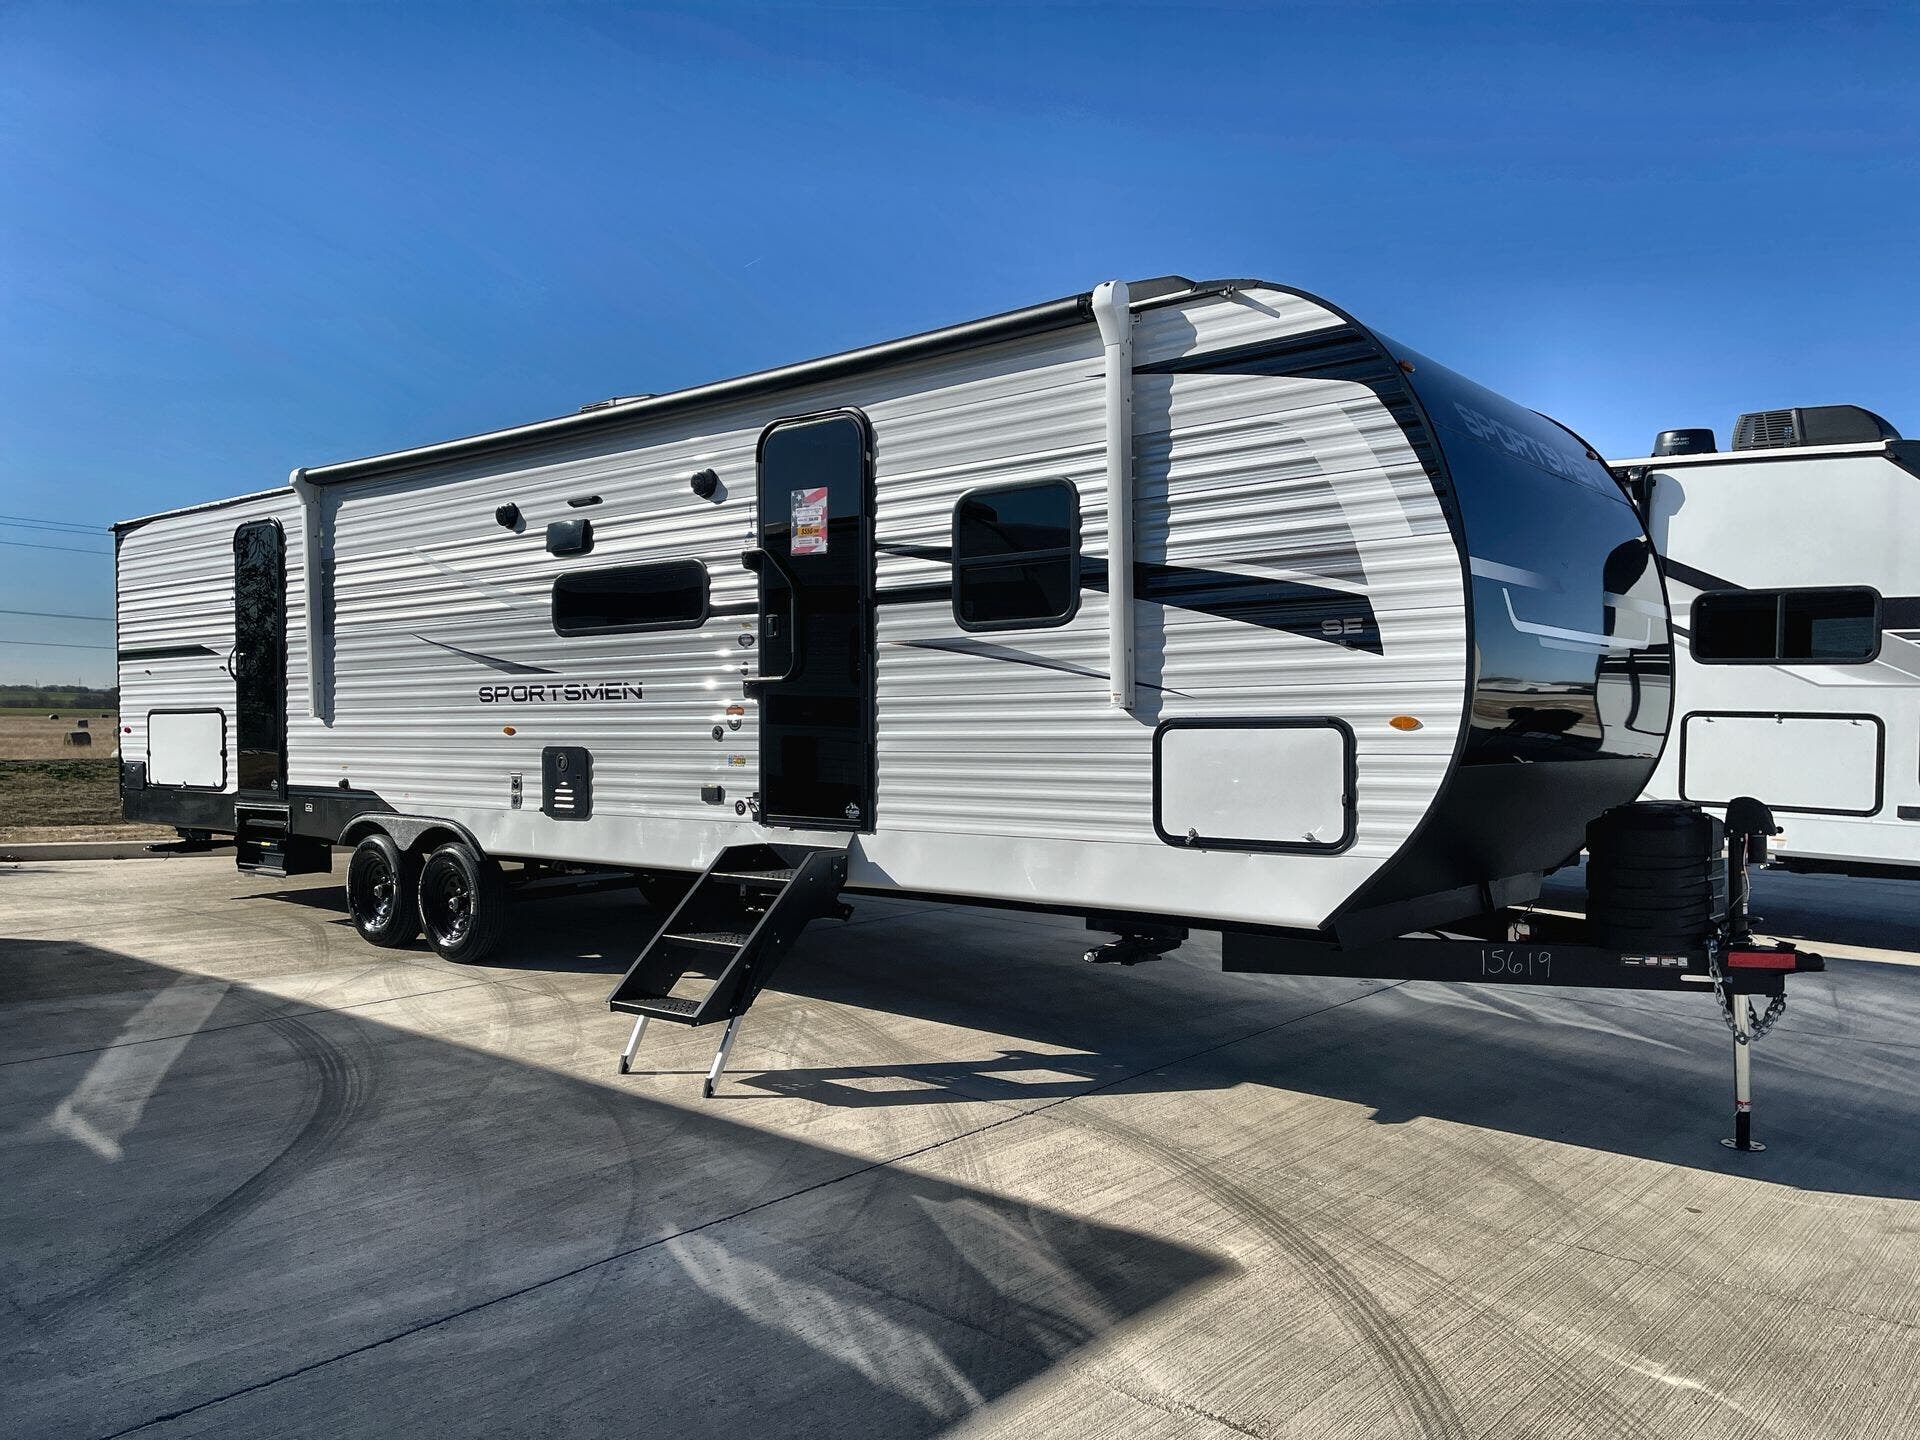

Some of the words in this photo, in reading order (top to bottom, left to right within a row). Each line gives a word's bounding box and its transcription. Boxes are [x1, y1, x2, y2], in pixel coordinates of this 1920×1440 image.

[1321, 617, 1364, 636] SE
[478, 682, 643, 703] SPORTSMEN
[1481, 949, 1552, 978] 15619
